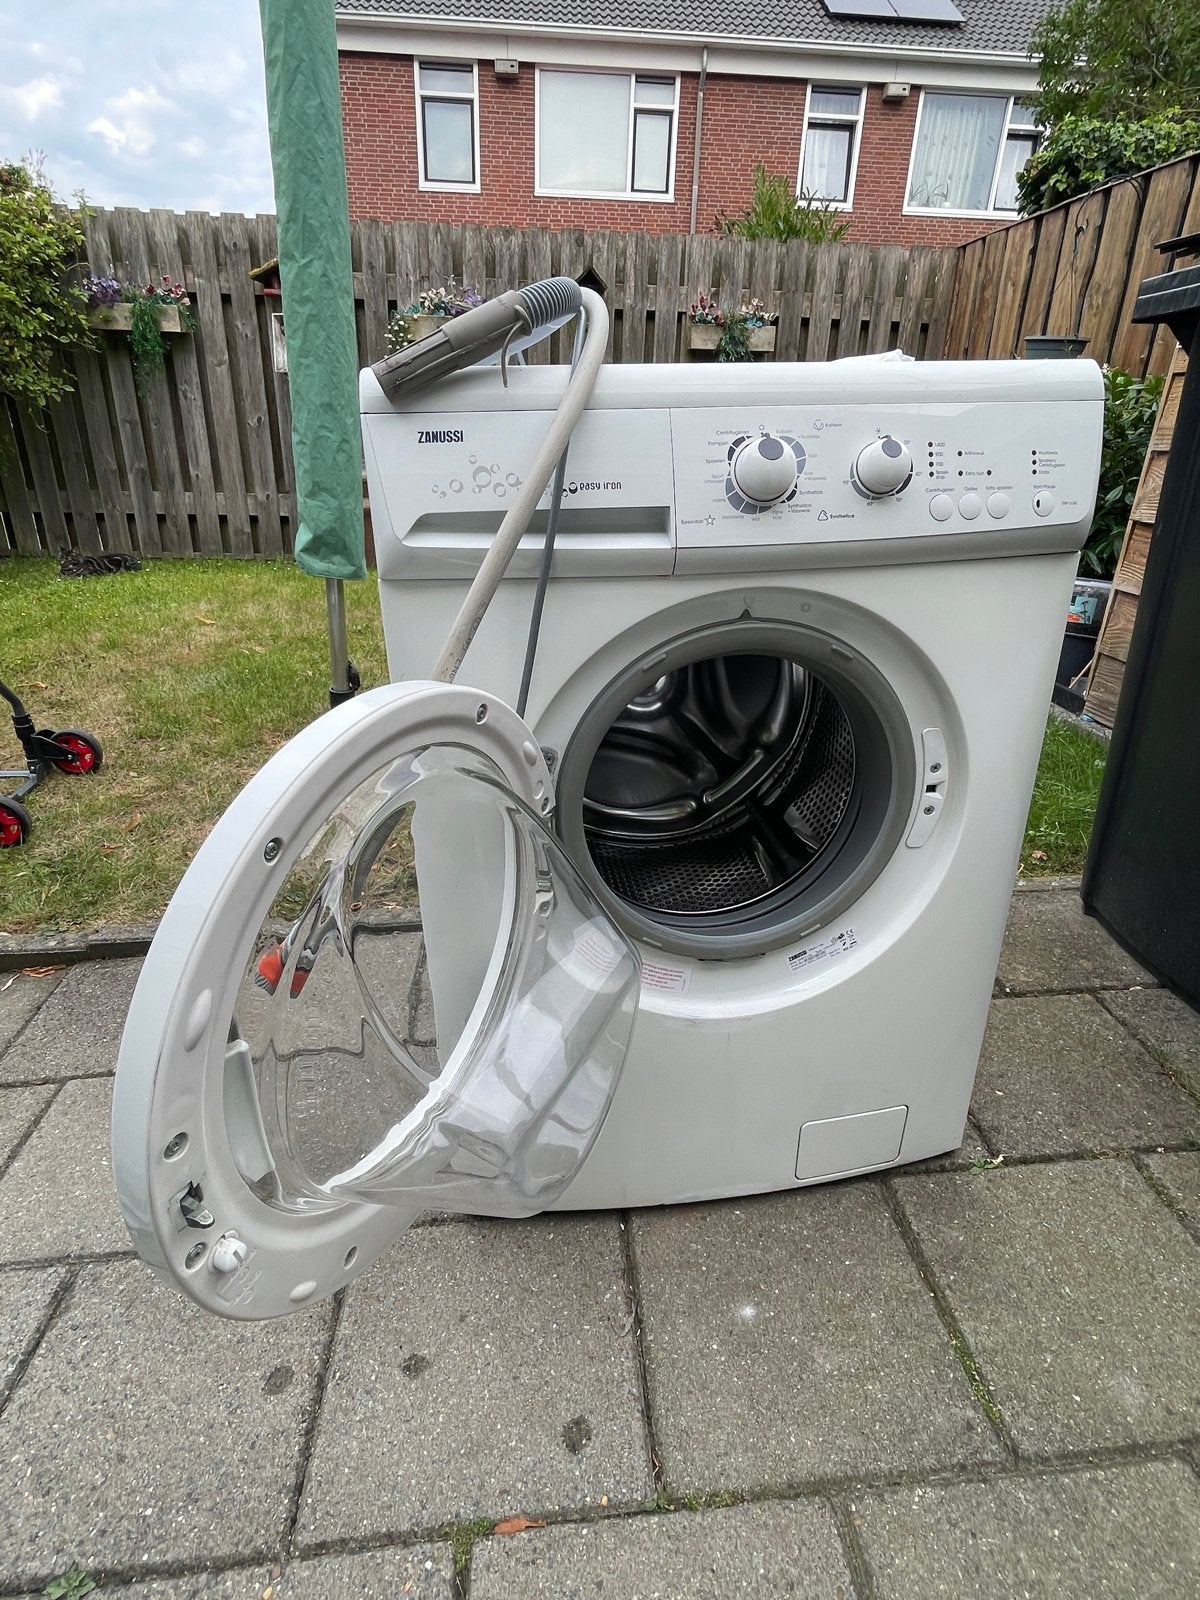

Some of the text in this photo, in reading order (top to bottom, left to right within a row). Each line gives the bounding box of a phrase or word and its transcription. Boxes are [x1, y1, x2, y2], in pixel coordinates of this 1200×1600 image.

[418, 430, 464, 444] ZANUSSI
[580, 481, 622, 491] easy iron
